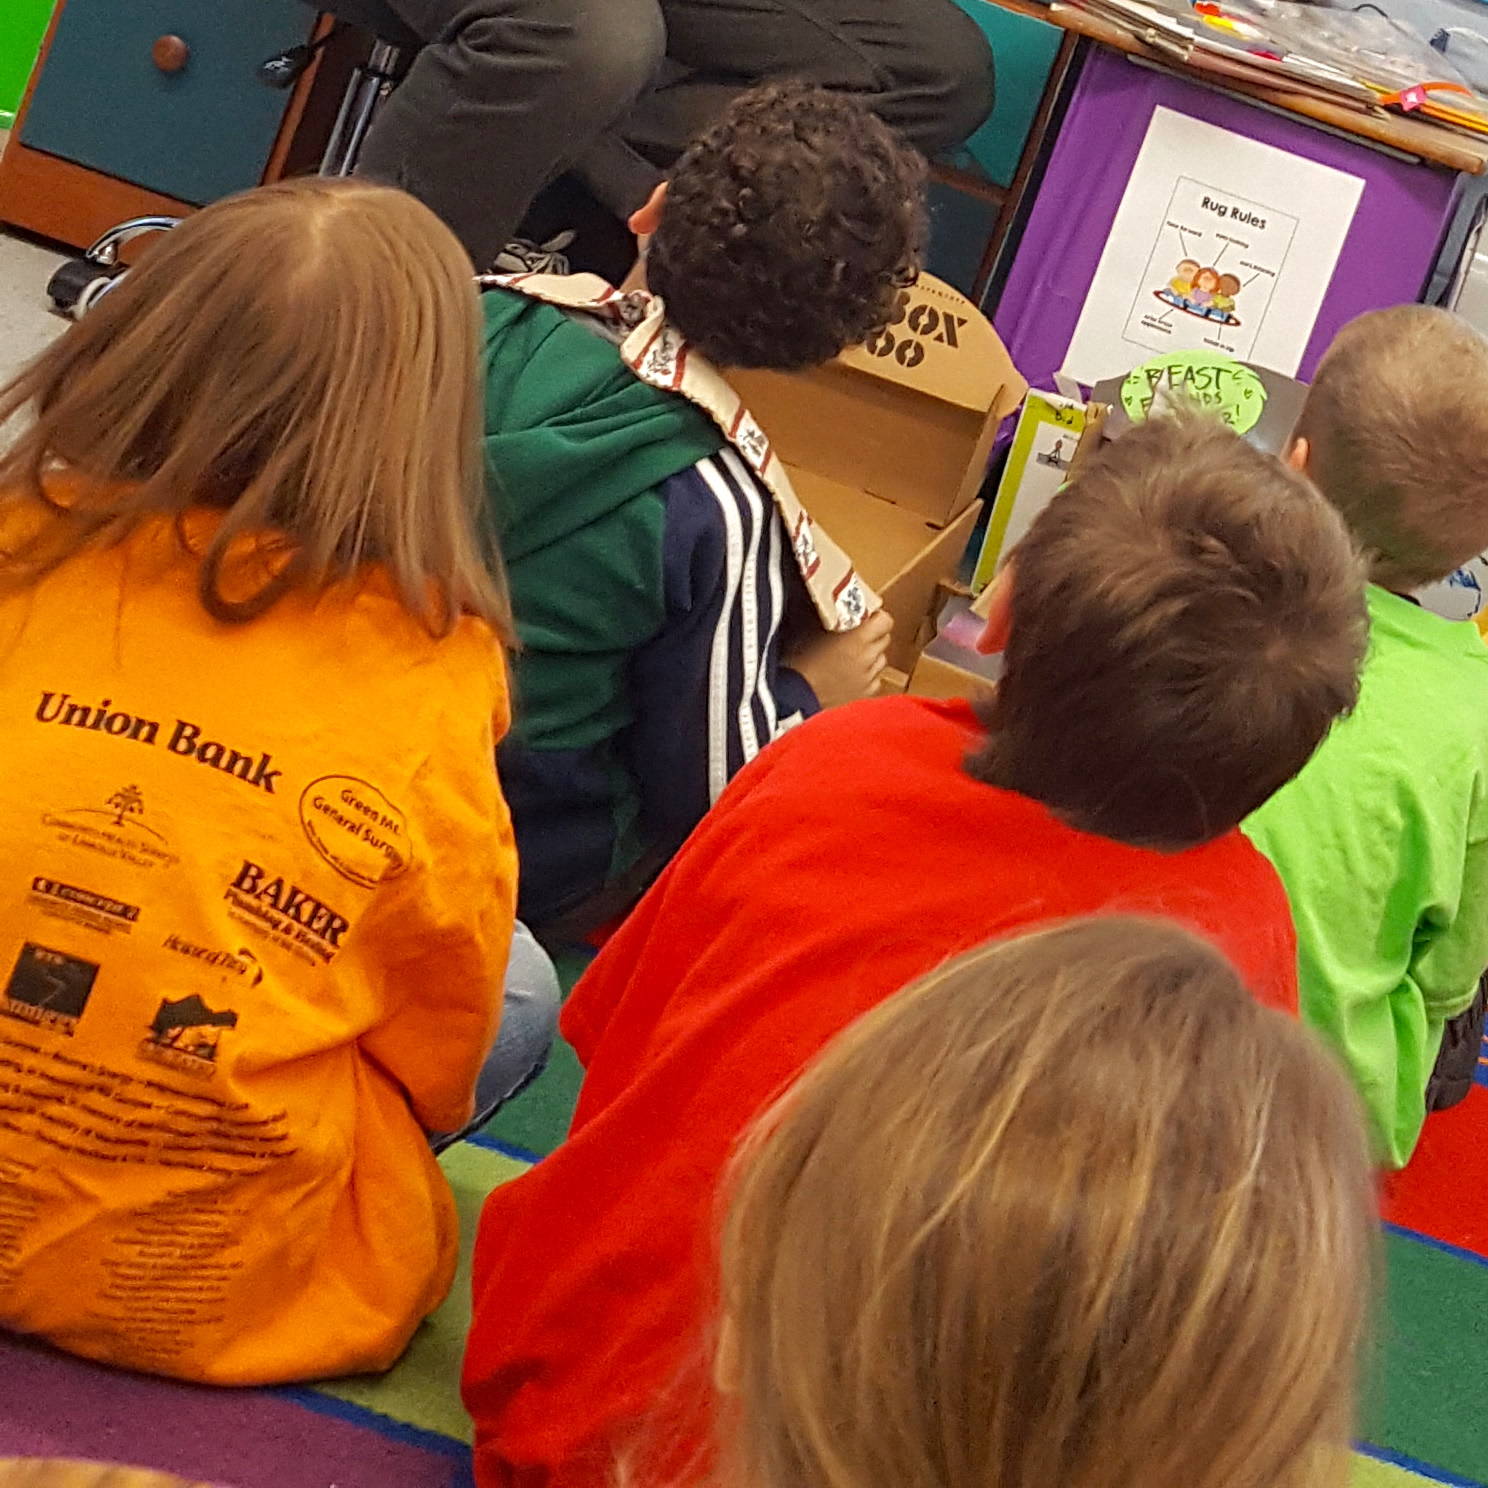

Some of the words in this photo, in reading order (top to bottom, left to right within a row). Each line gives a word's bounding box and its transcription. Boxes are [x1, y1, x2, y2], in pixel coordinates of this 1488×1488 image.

[1201, 196, 1228, 217] Rug
[1230, 207, 1267, 230] Rules
[35, 690, 160, 746] Union
[167, 718, 283, 794] Bank
[313, 796, 363, 833] General
[340, 789, 378, 820] Green
[230, 859, 350, 949] BAKER
